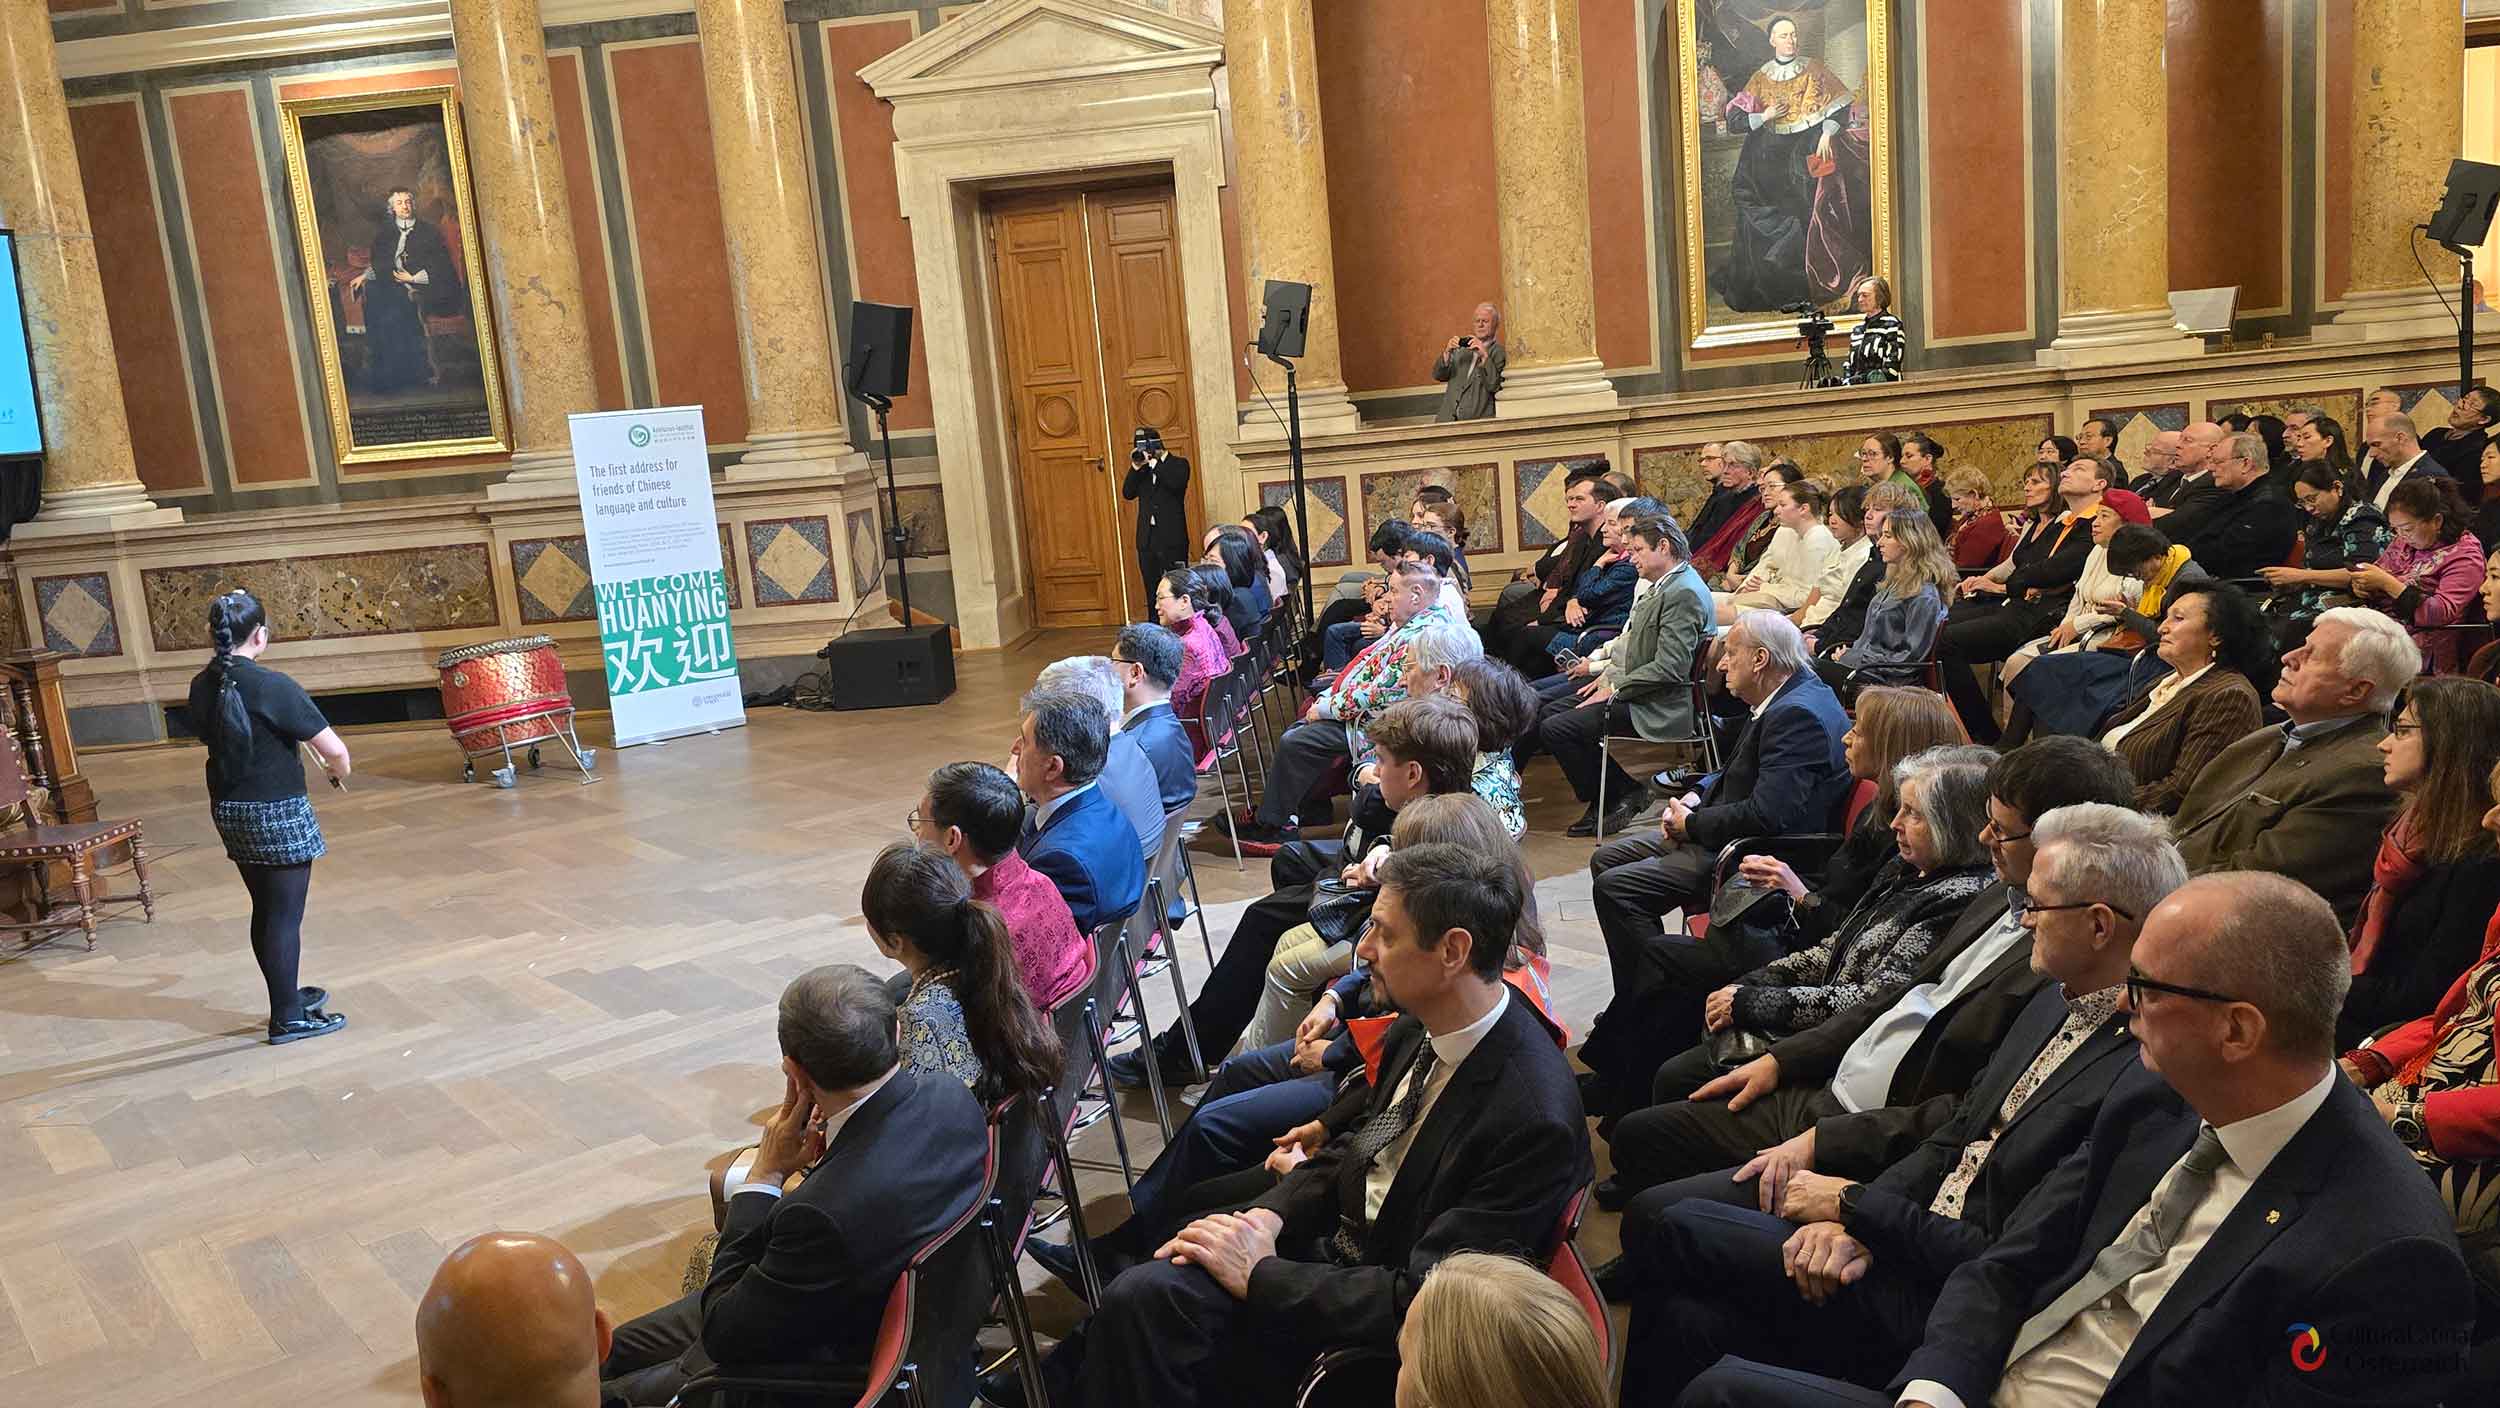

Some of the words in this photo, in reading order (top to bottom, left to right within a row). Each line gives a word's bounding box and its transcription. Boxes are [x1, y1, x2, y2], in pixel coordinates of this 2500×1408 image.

[589, 465, 606, 478] The
[608, 463, 627, 476] first
[630, 460, 664, 474] address
[665, 457, 678, 471] for
[592, 482, 625, 496] friends
[626, 480, 635, 494] of
[638, 479, 672, 492] Chinese
[595, 502, 636, 517] language
[638, 497, 654, 511] and
[656, 495, 687, 509] culture
[597, 568, 722, 601] WELCOME
[599, 586, 727, 634] HUANYING
[603, 621, 736, 694] 欢迎
